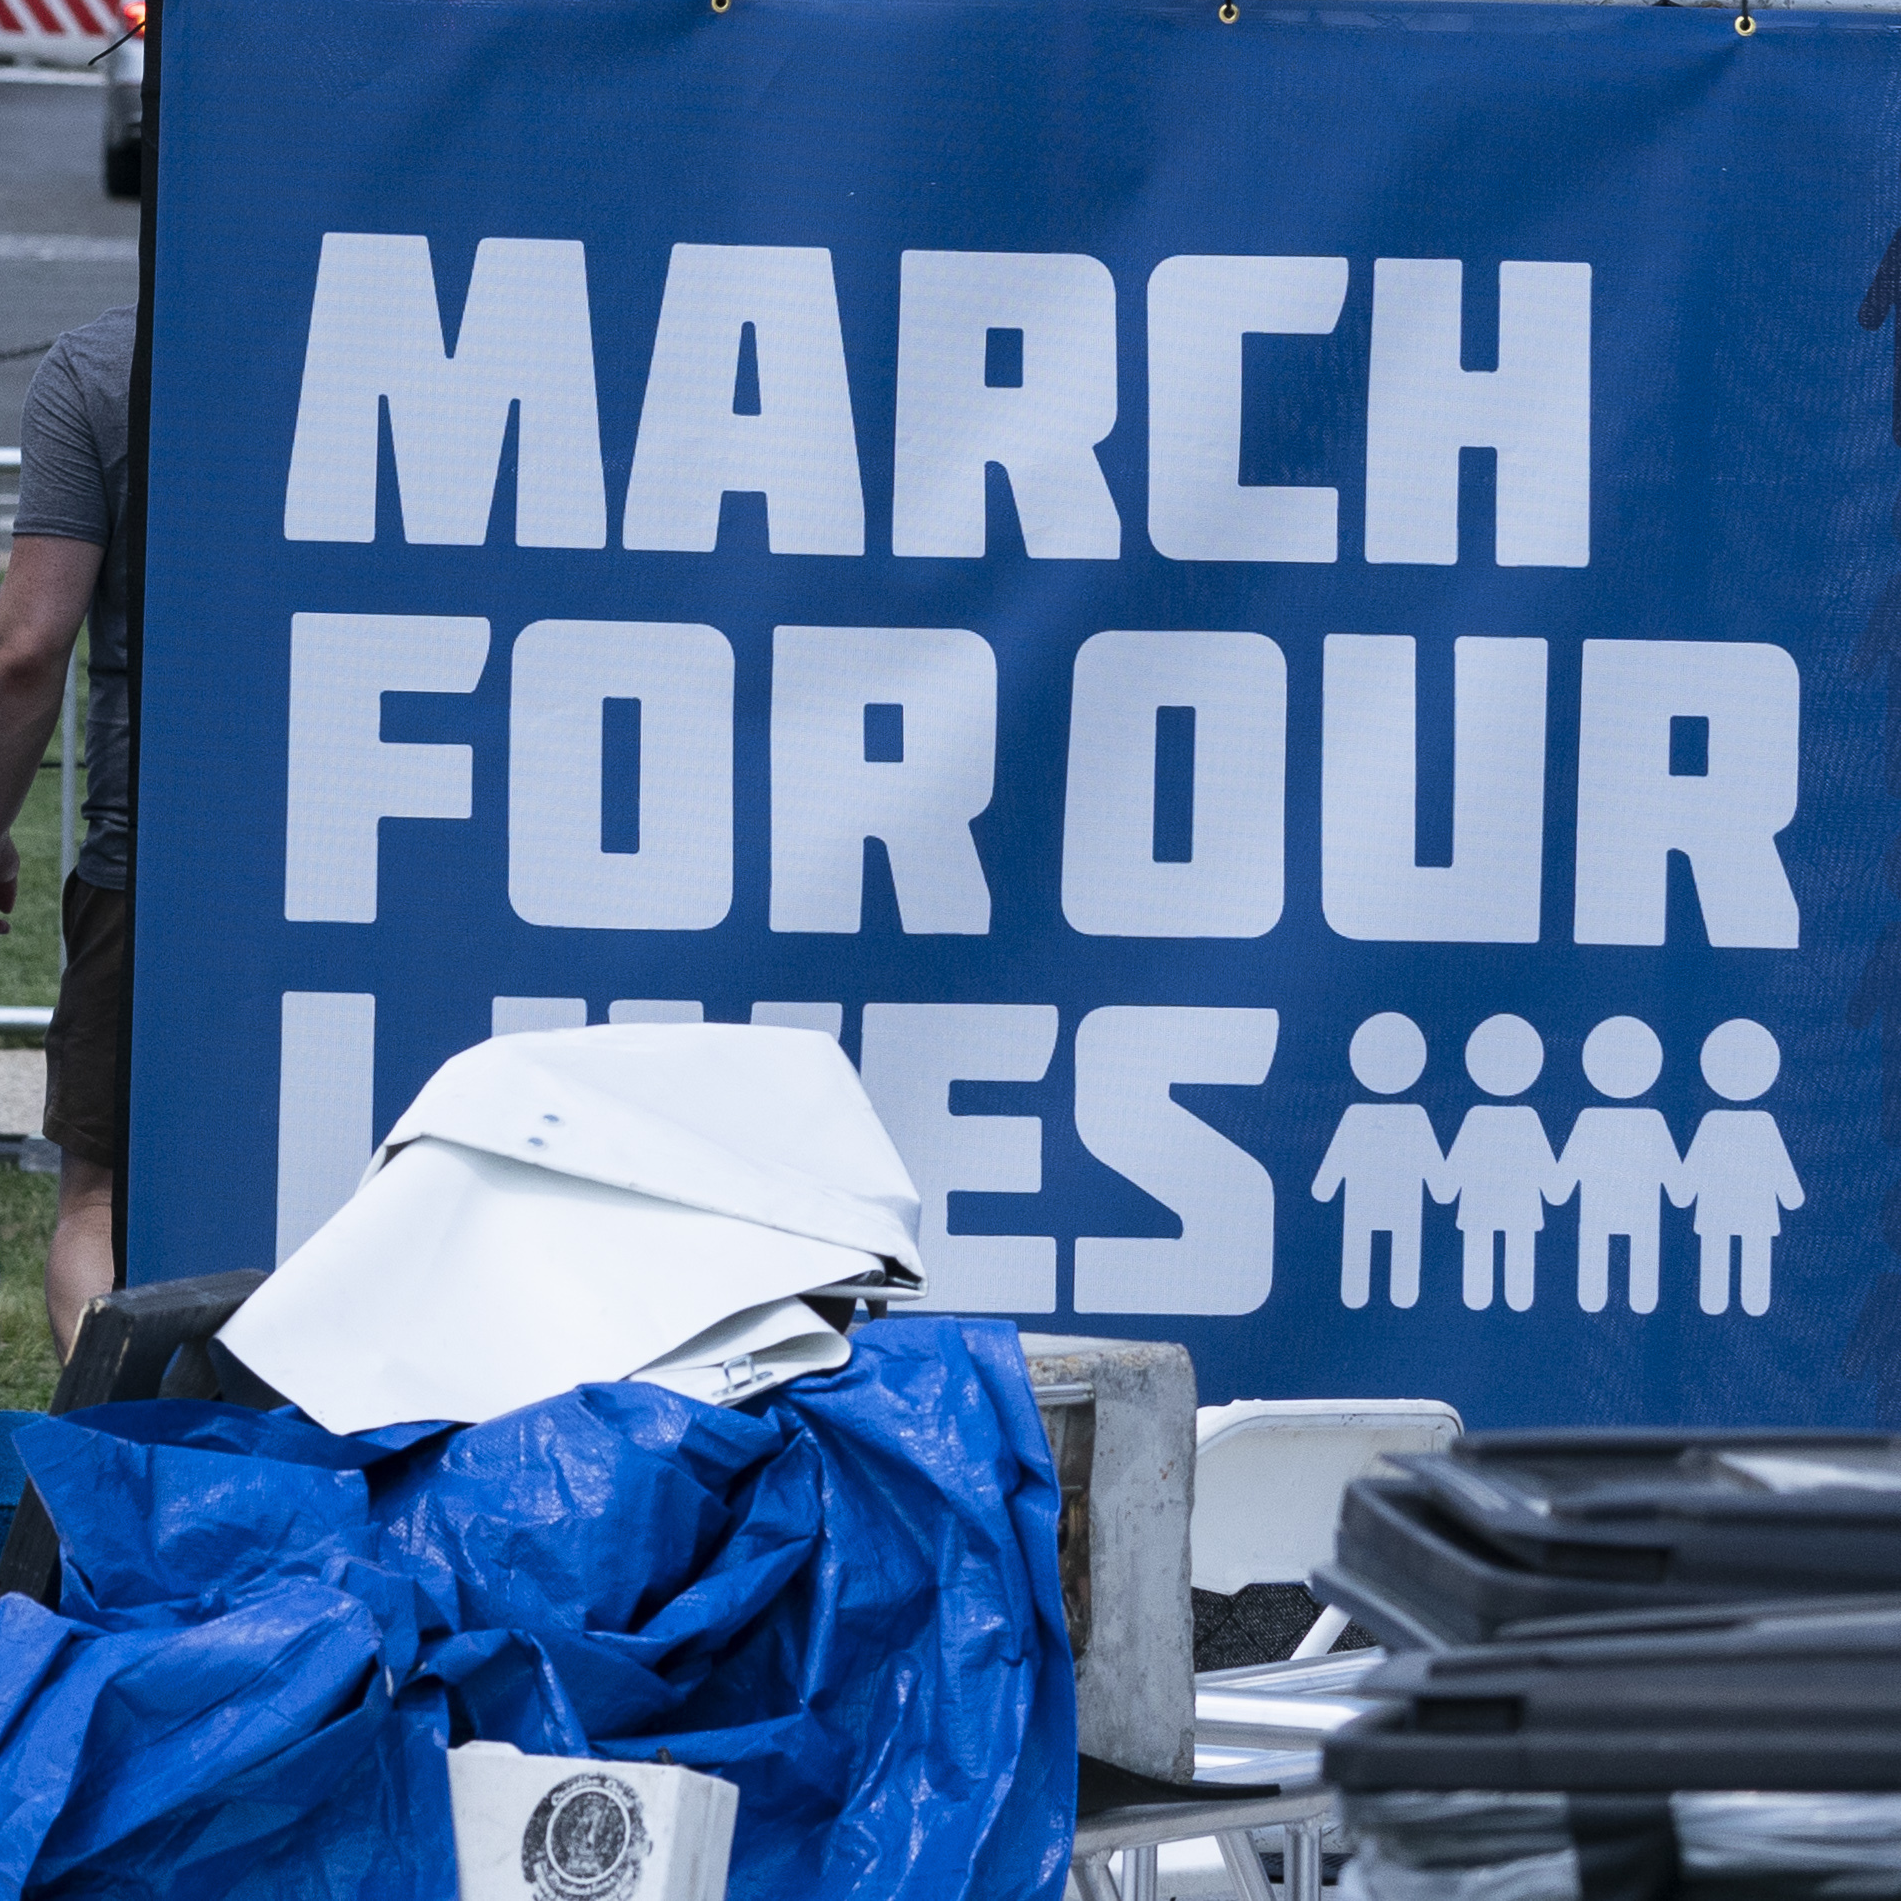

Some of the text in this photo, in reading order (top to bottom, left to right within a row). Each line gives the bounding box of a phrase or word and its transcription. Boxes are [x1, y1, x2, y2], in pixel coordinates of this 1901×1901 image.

[285, 233, 1591, 567] MARCH
[285, 613, 1799, 948] FOR OUR
[275, 992, 1279, 1316] LES
